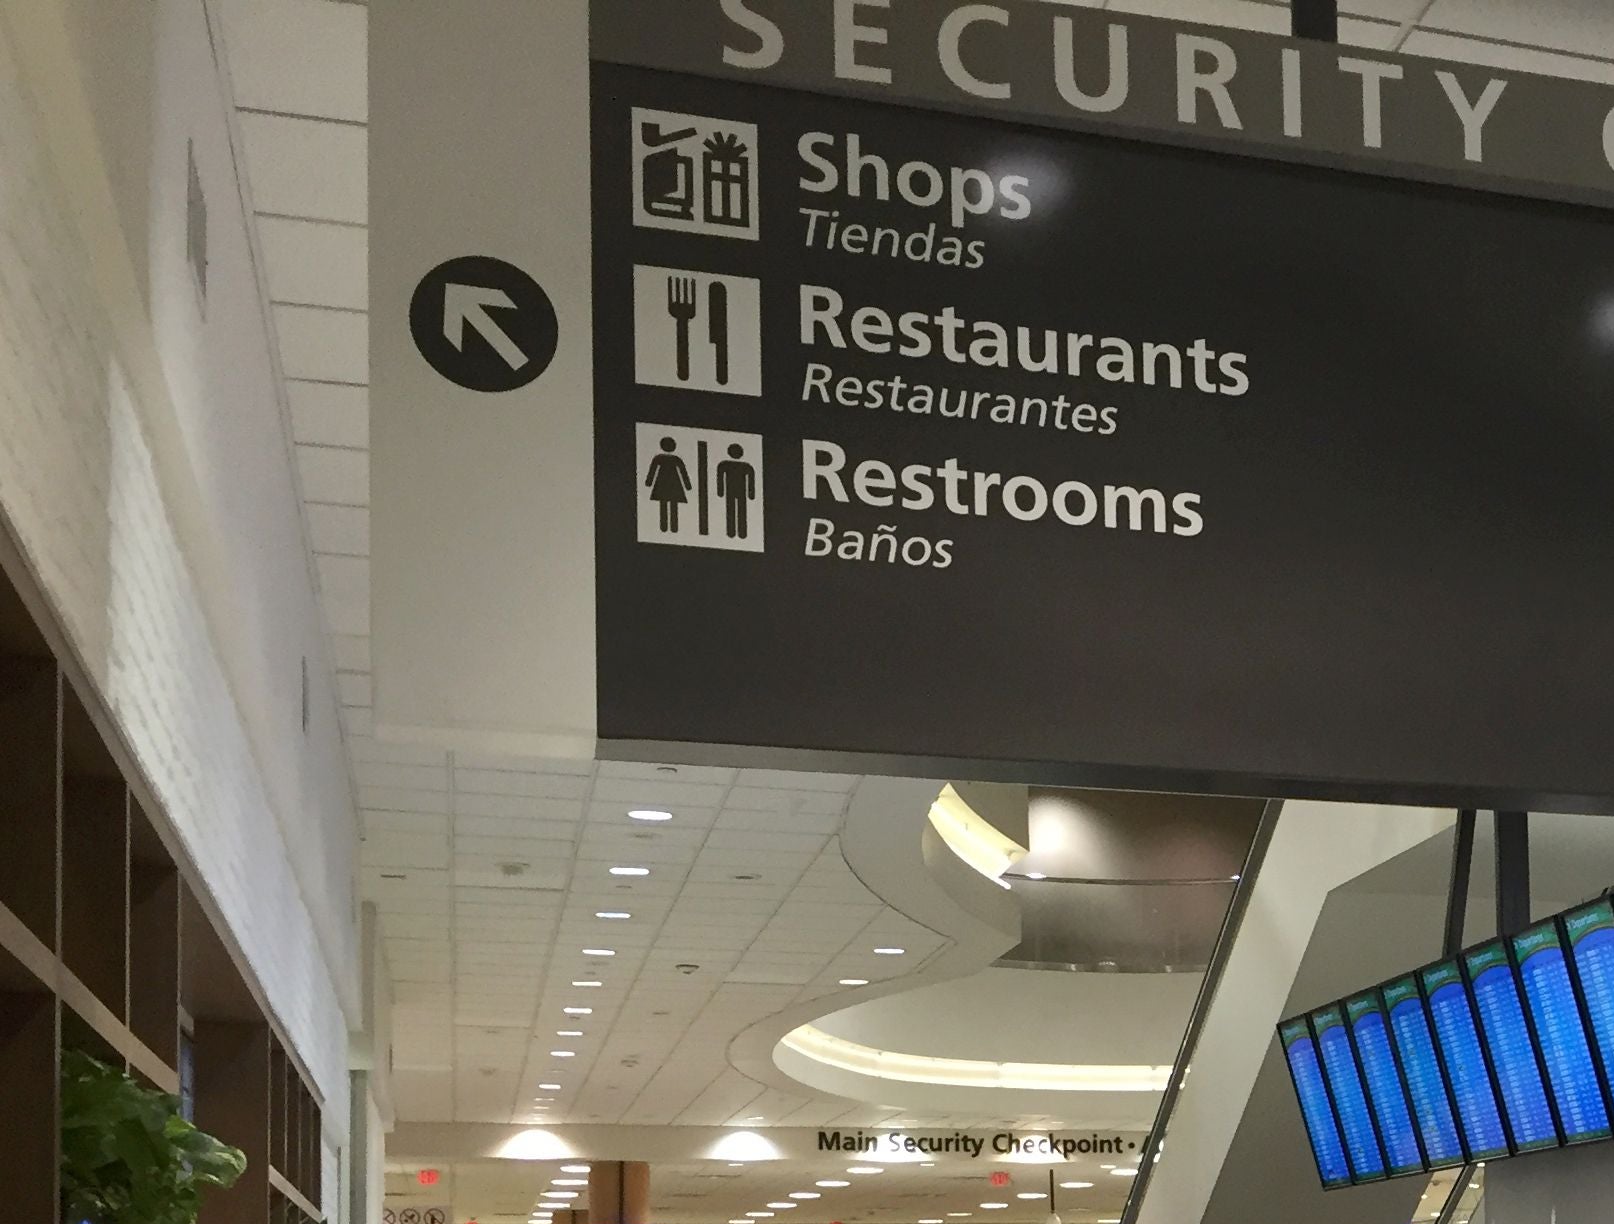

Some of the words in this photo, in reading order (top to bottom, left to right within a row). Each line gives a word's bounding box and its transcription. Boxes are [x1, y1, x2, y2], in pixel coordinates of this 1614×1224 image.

[720, 0, 1508, 163] SECURITY
[797, 131, 1033, 228] Shops
[798, 207, 986, 269] Tiendas
[800, 284, 1250, 397] Restaurants
[801, 363, 1119, 436] Restaurantes
[801, 438, 1205, 538] Restrooms
[803, 517, 955, 570] Baños
[817, 1131, 878, 1152] Main
[888, 1132, 985, 1158] Security
[992, 1131, 1124, 1160] Checkpoint
